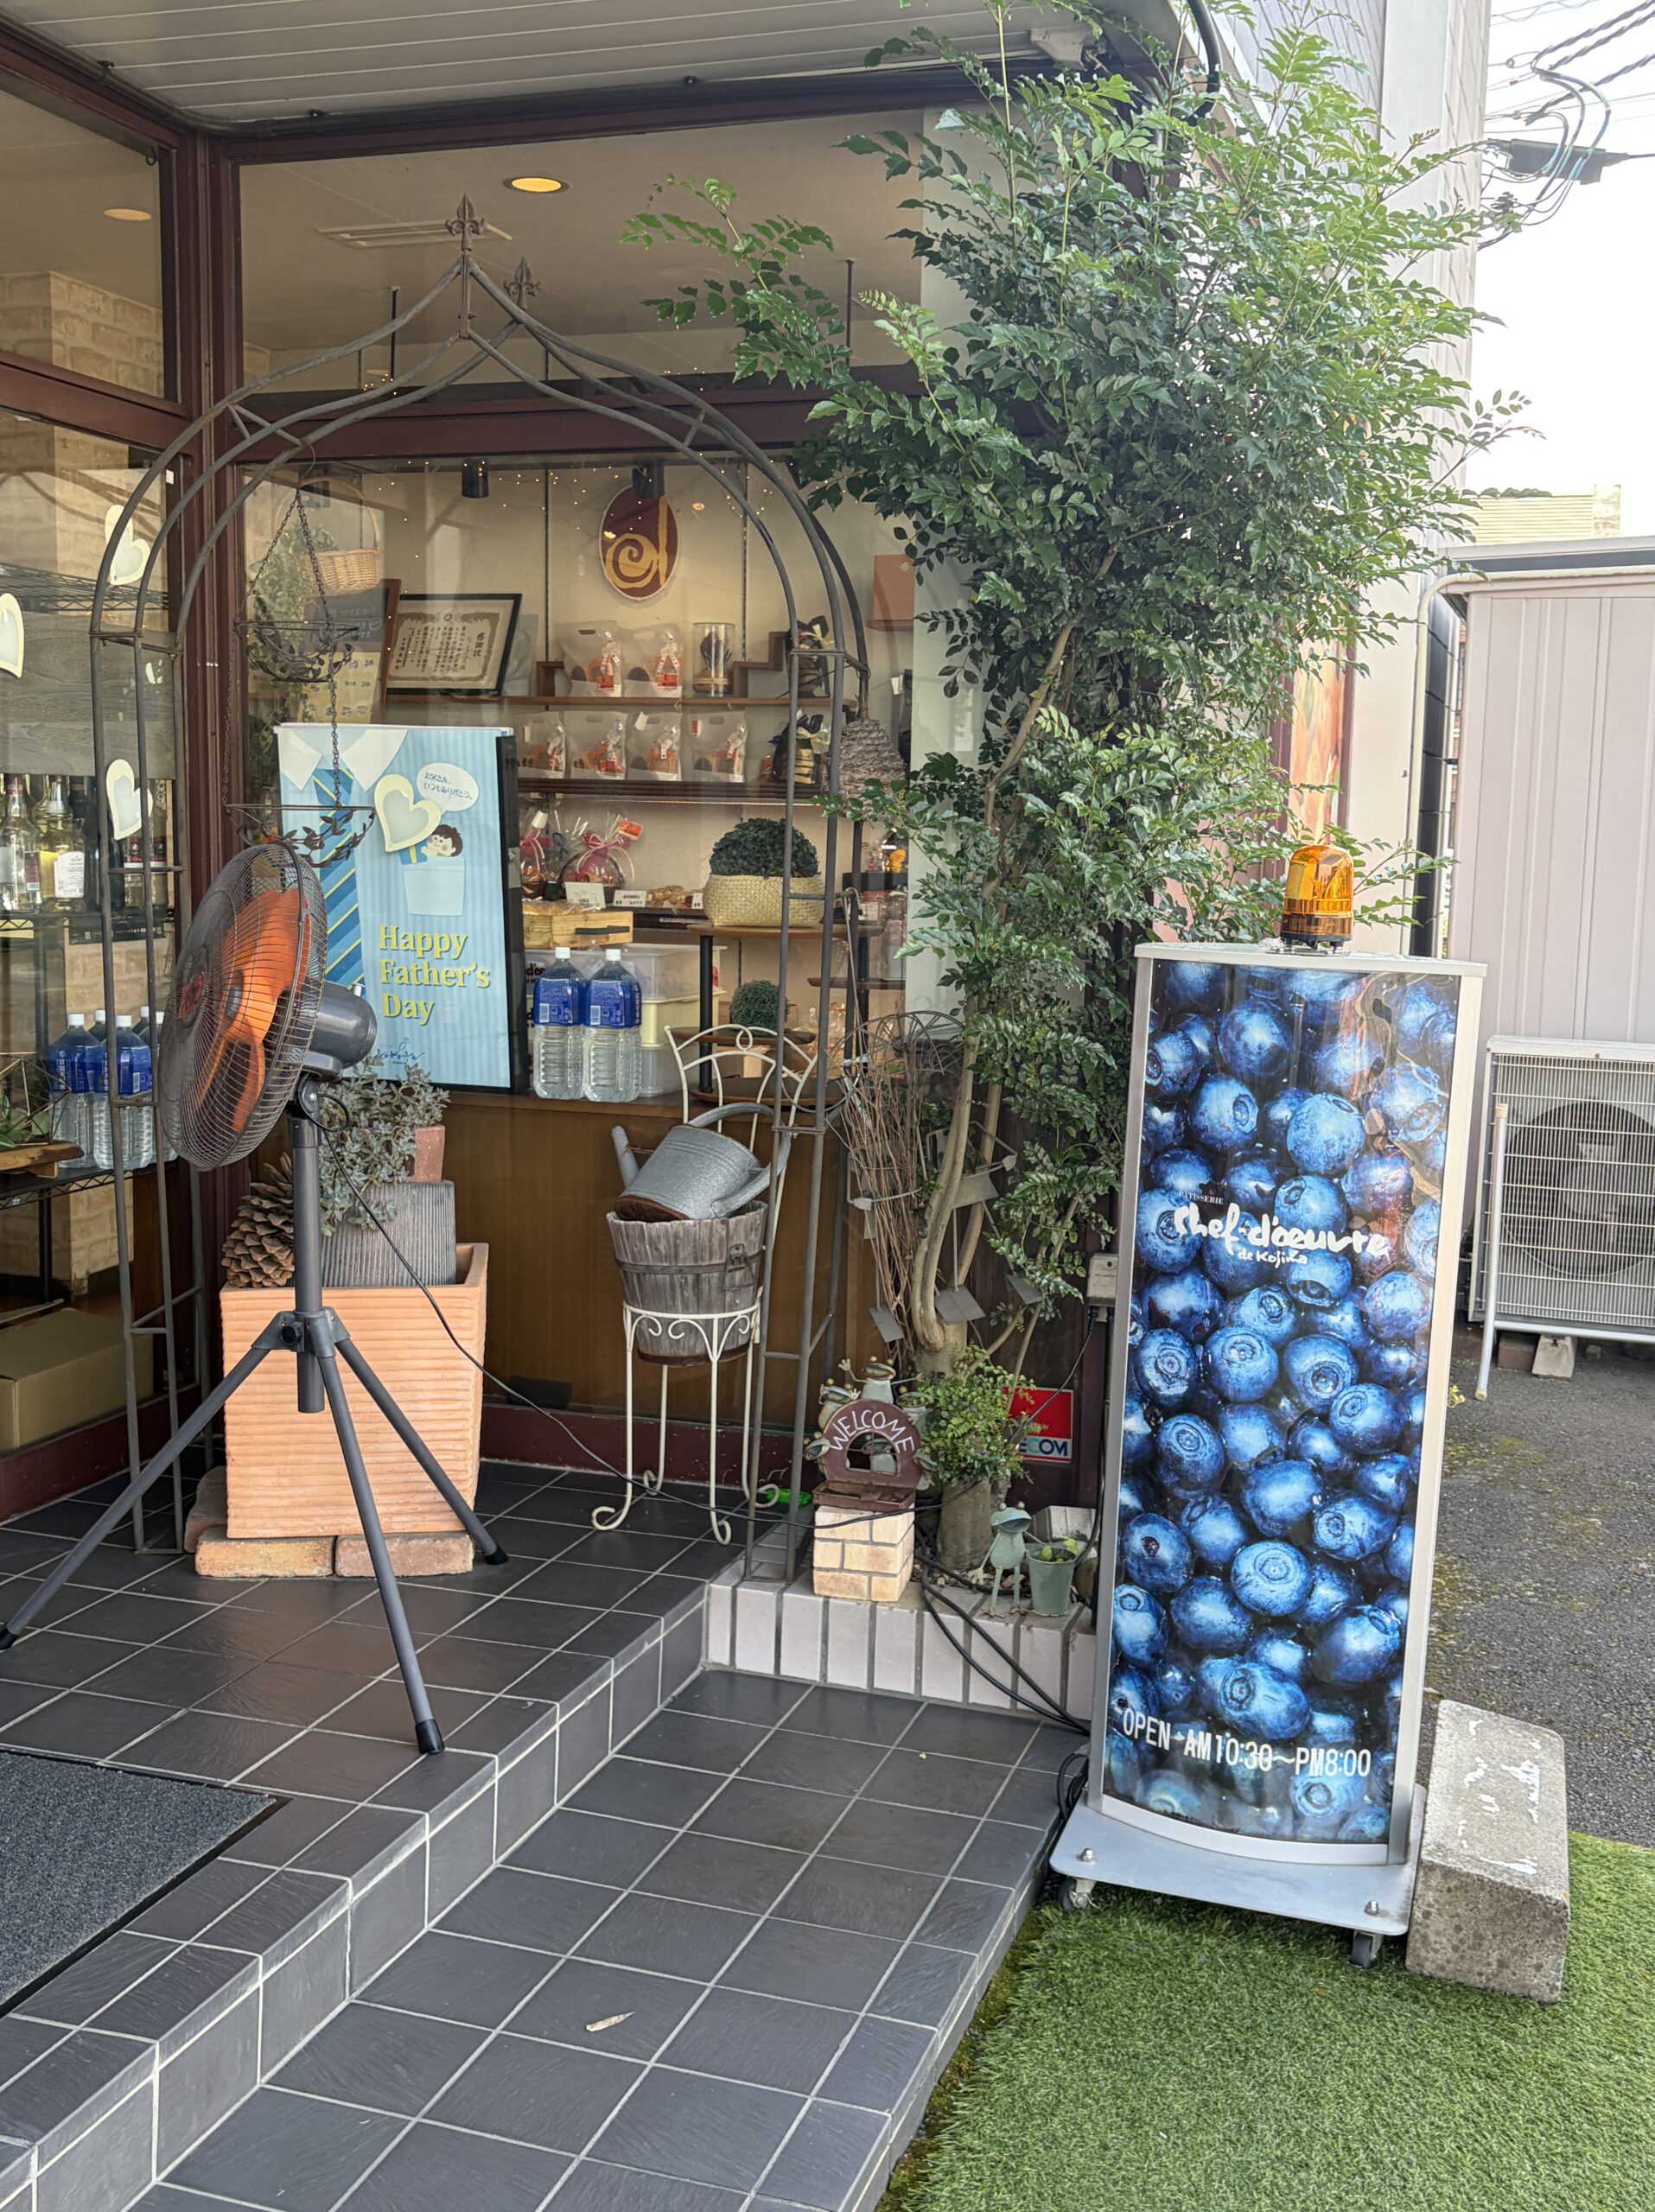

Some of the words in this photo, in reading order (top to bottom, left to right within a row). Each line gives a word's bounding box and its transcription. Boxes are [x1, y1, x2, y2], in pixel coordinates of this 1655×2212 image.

[379, 925, 468, 960] Happy
[379, 959, 491, 988] Father's
[382, 993, 436, 1026] Day
[1238, 1247, 1253, 1261] de
[829, 1409, 916, 1455] WELCOME
[1018, 1436, 1069, 1458] ECOM
